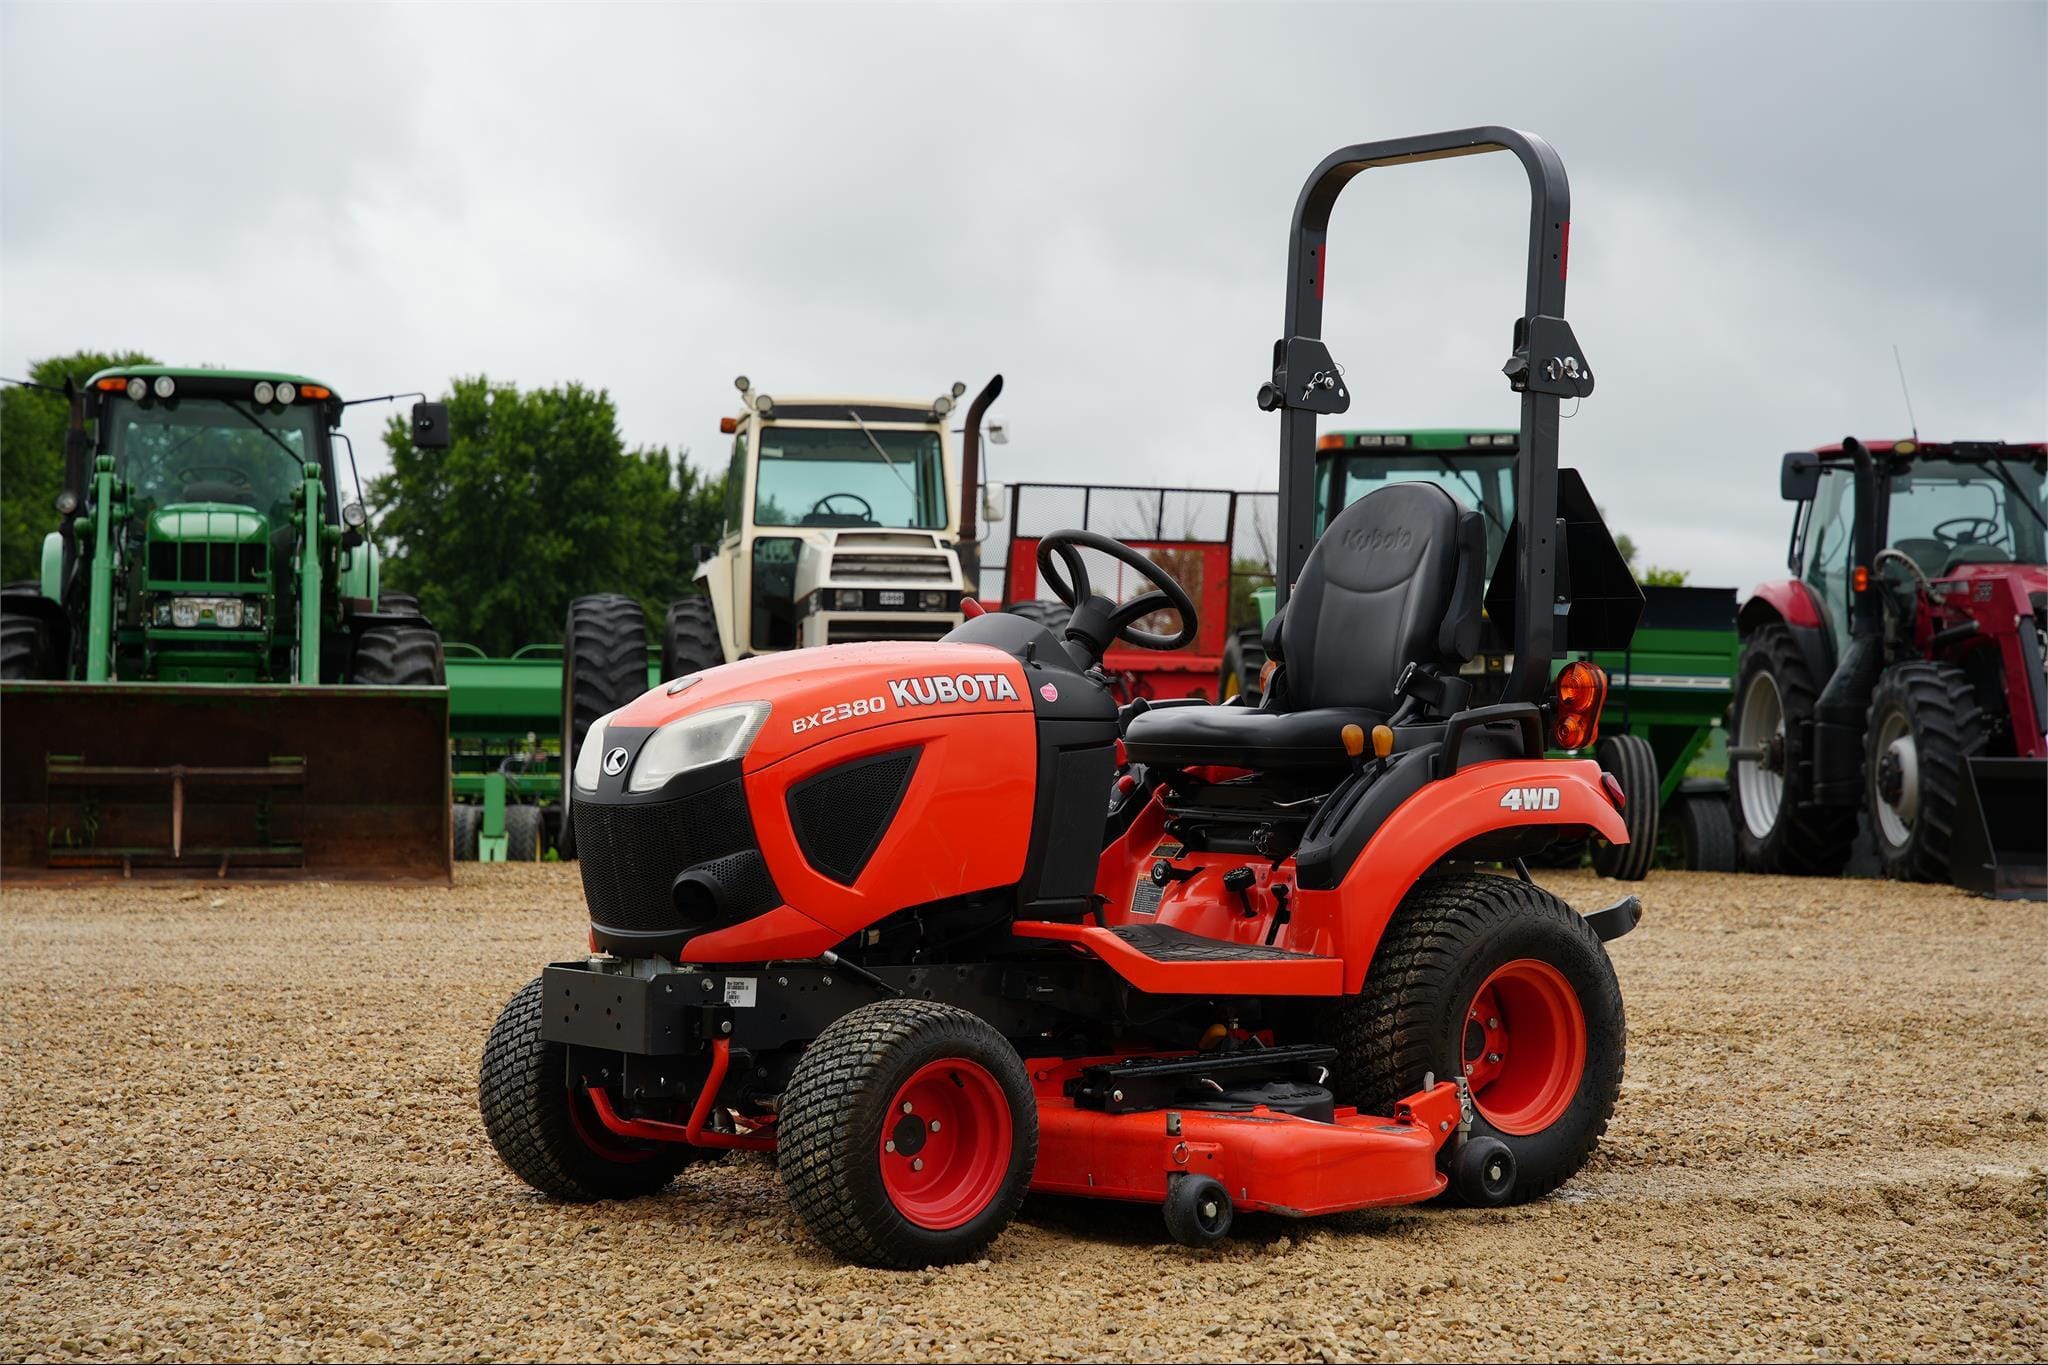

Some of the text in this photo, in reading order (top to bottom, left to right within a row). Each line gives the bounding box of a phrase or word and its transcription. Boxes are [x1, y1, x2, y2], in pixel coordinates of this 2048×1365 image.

[1342, 526, 1412, 552] Kubota
[888, 674, 1019, 707] KUBOTA
[792, 696, 886, 734] BX2380
[1500, 787, 1560, 811] 4WD
